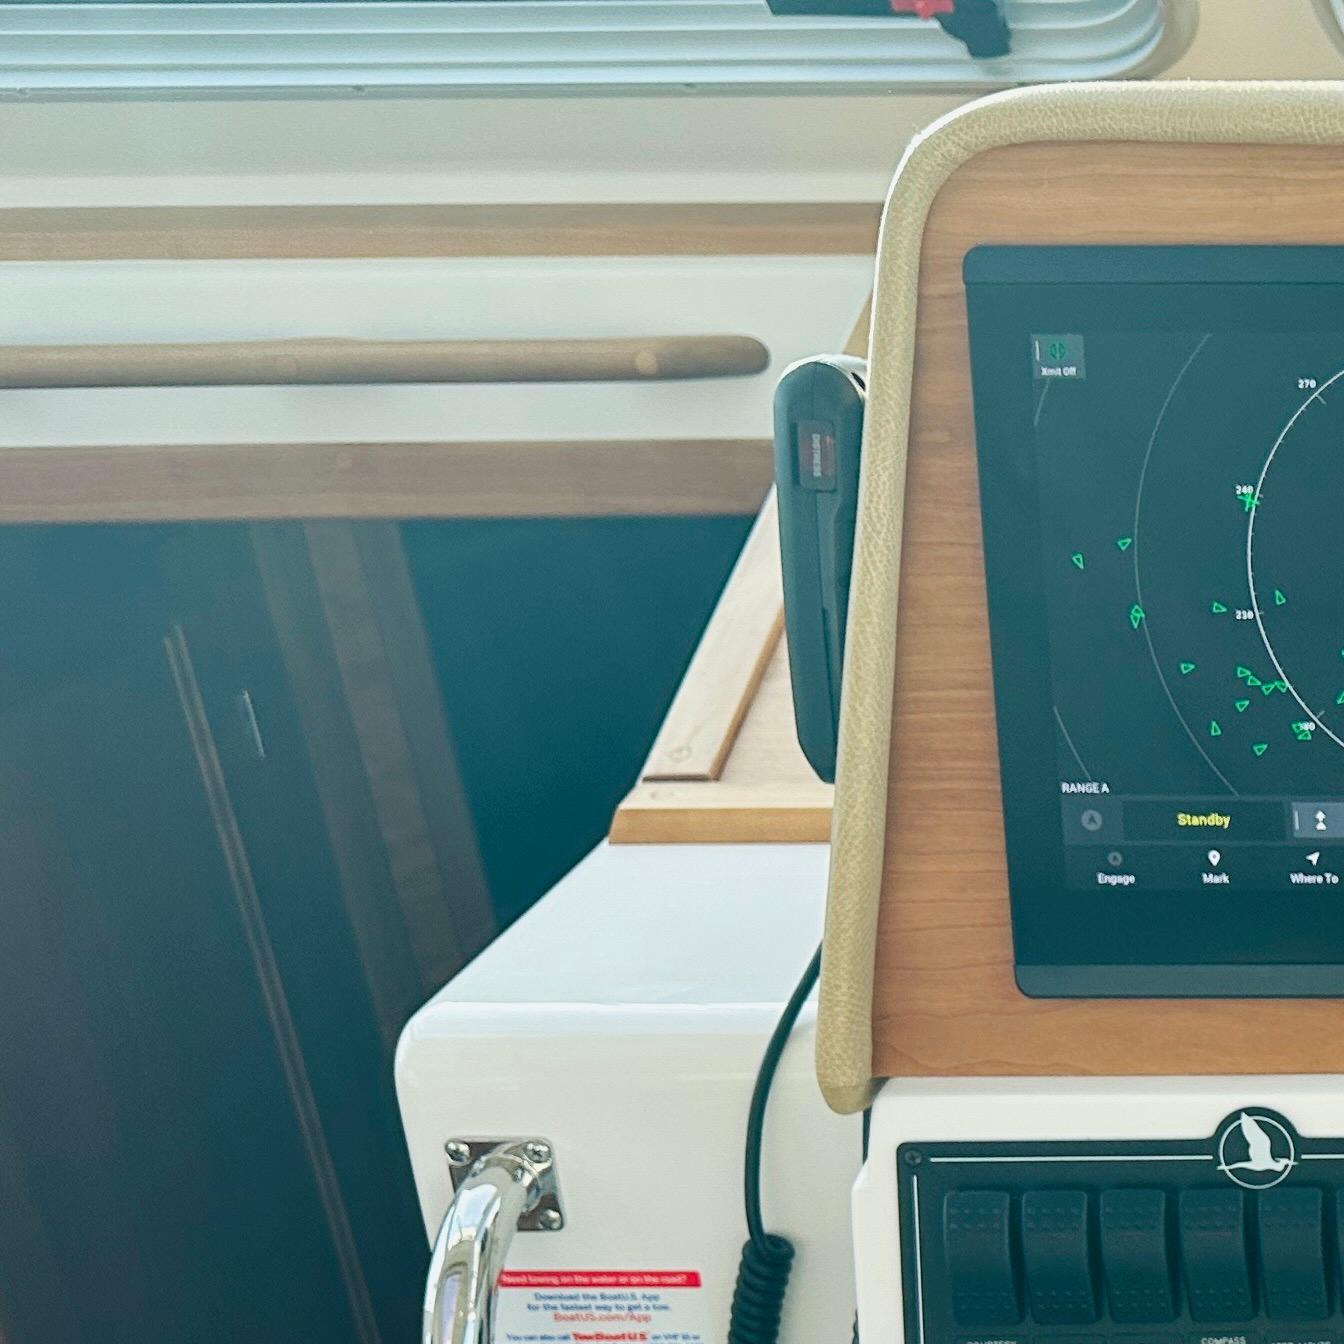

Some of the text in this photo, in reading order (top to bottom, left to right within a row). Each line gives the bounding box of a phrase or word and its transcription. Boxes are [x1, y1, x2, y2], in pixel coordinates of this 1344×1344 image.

[1298, 379, 1316, 389] 270
[1061, 782, 1100, 794] RANGE
[1177, 812, 1231, 829] Standby
[1097, 872, 1135, 886] Engage
[1202, 872, 1230, 884] Mark
[1290, 872, 1339, 884] Where To
